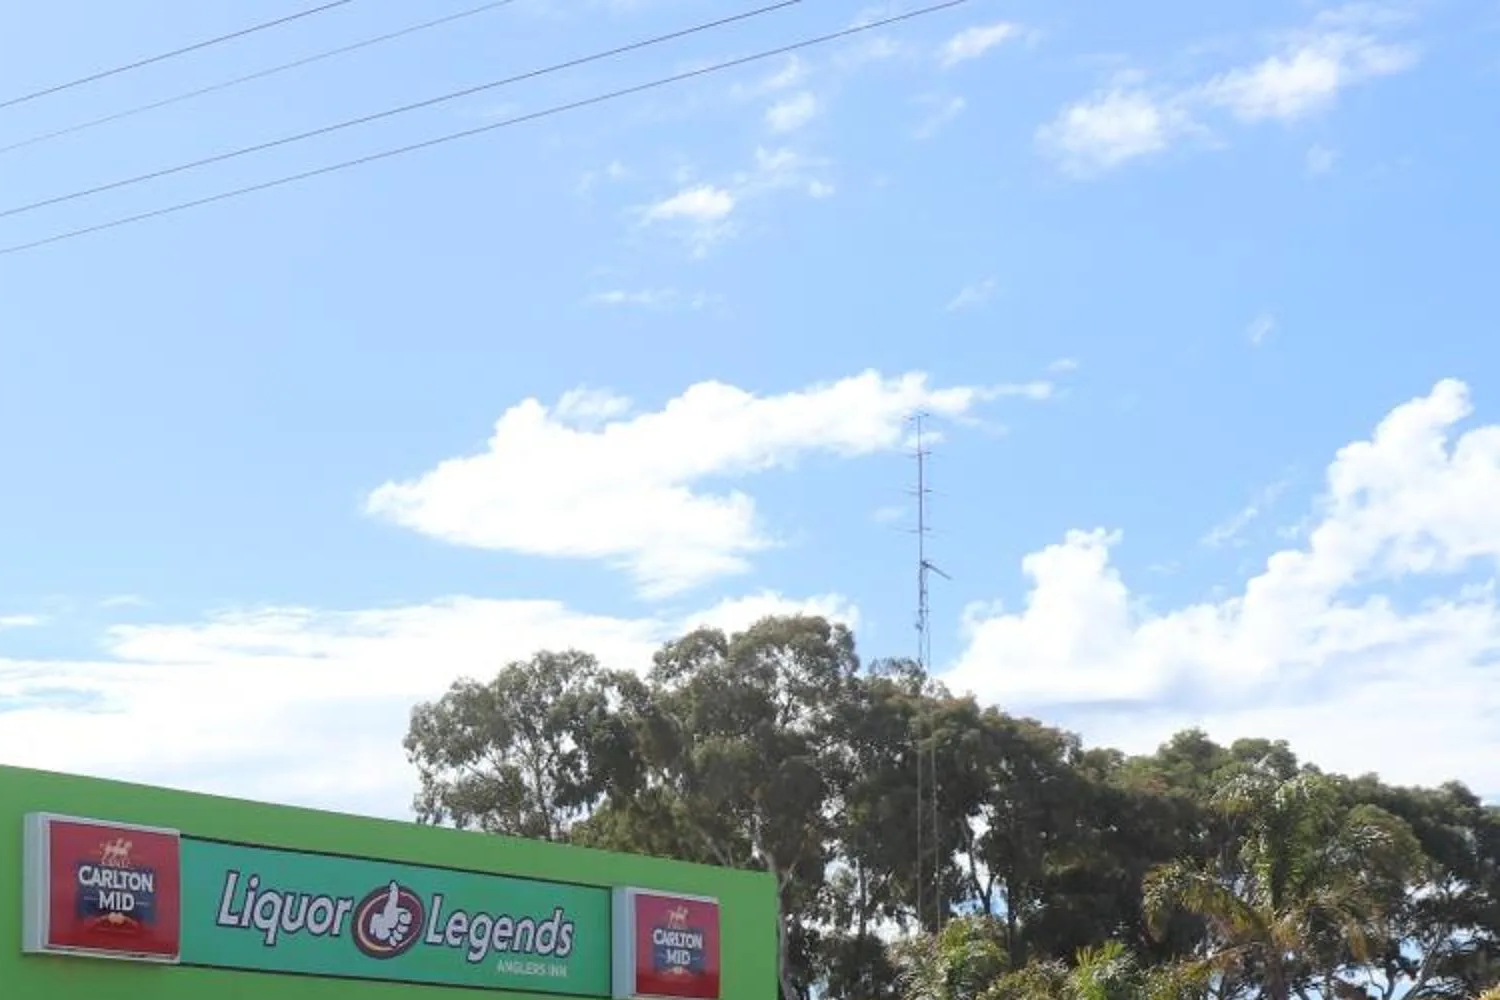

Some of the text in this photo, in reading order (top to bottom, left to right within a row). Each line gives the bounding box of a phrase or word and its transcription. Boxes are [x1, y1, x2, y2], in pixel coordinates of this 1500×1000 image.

[78, 865, 154, 893] CARLTON
[99, 889, 135, 911] MID
[216, 869, 574, 964] Liquor Legends
[653, 928, 703, 949] CARLTON
[666, 949, 691, 965] MID
[496, 960, 548, 976] ANGLERS
